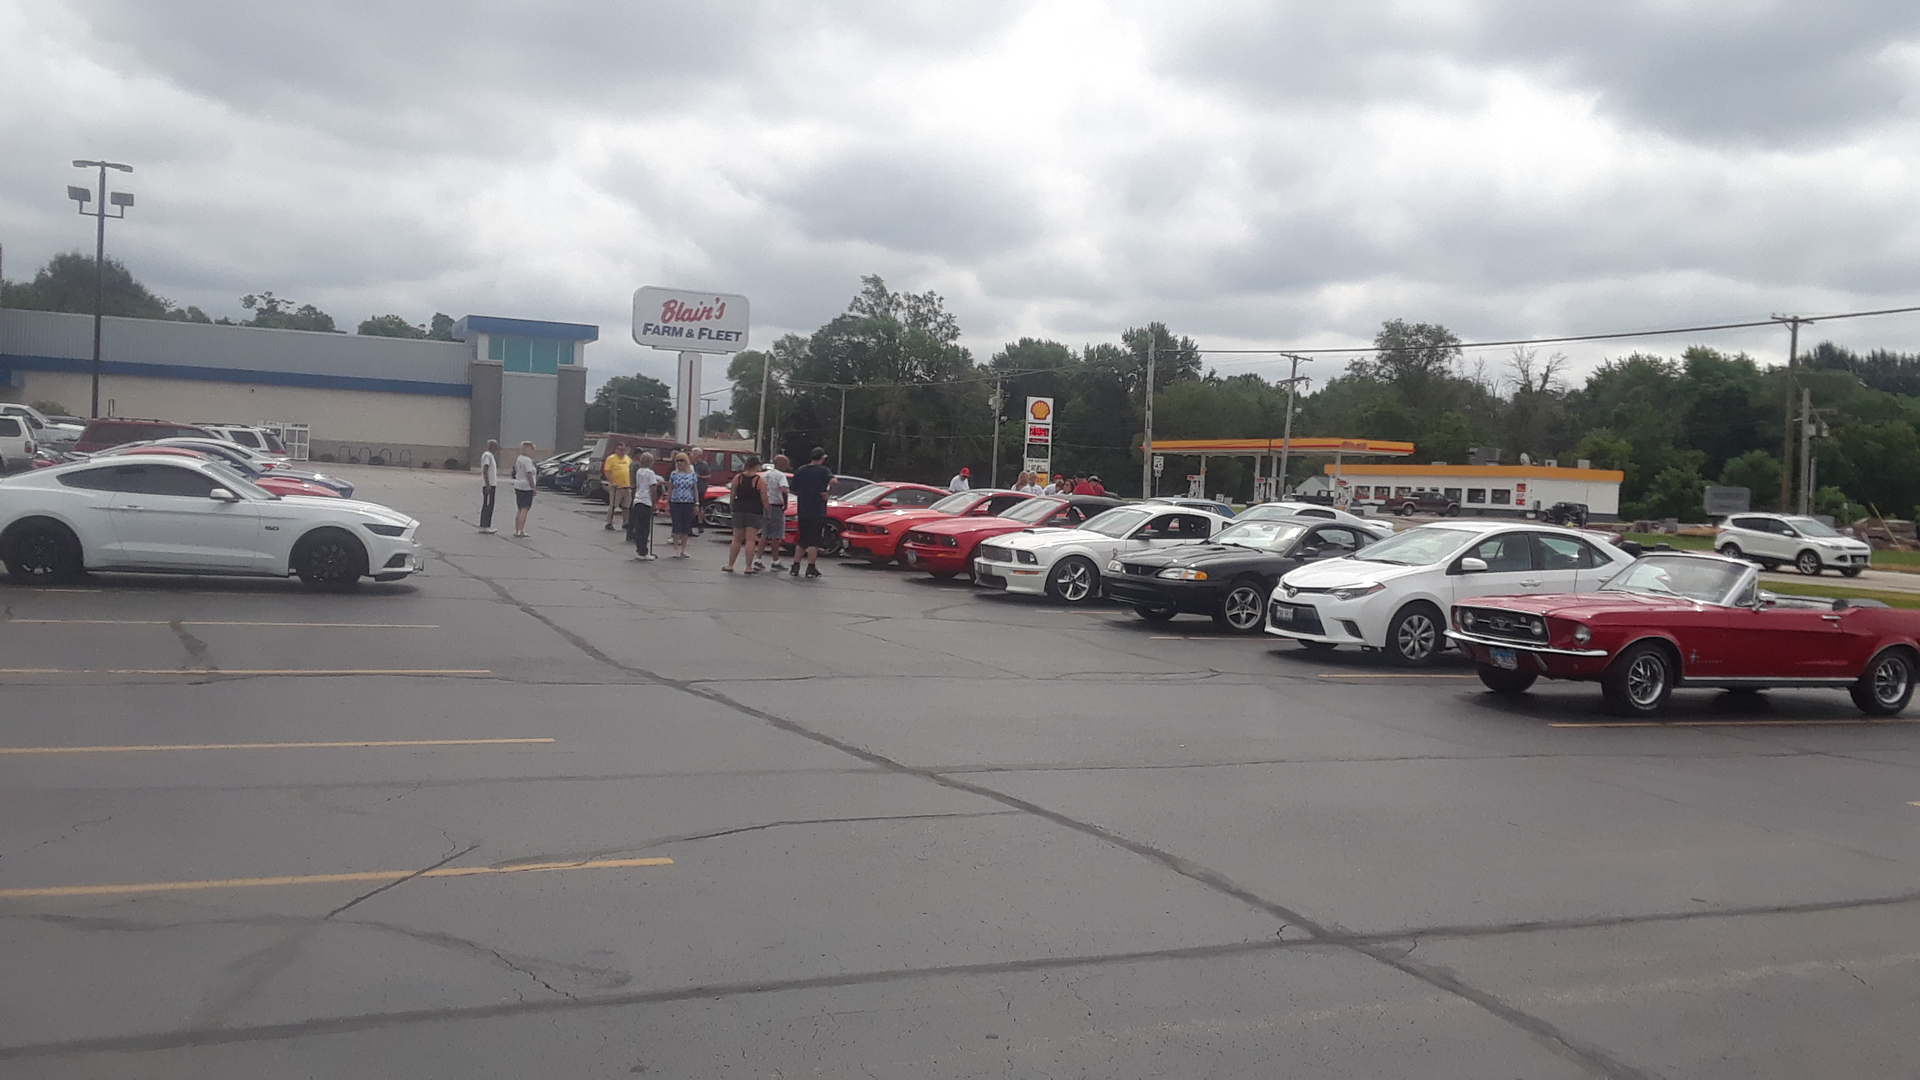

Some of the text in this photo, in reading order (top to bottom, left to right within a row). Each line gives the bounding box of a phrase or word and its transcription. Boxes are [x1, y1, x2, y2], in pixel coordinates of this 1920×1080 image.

[661, 297, 726, 324] Blain's
[642, 323, 742, 342] FARM & FLEET
